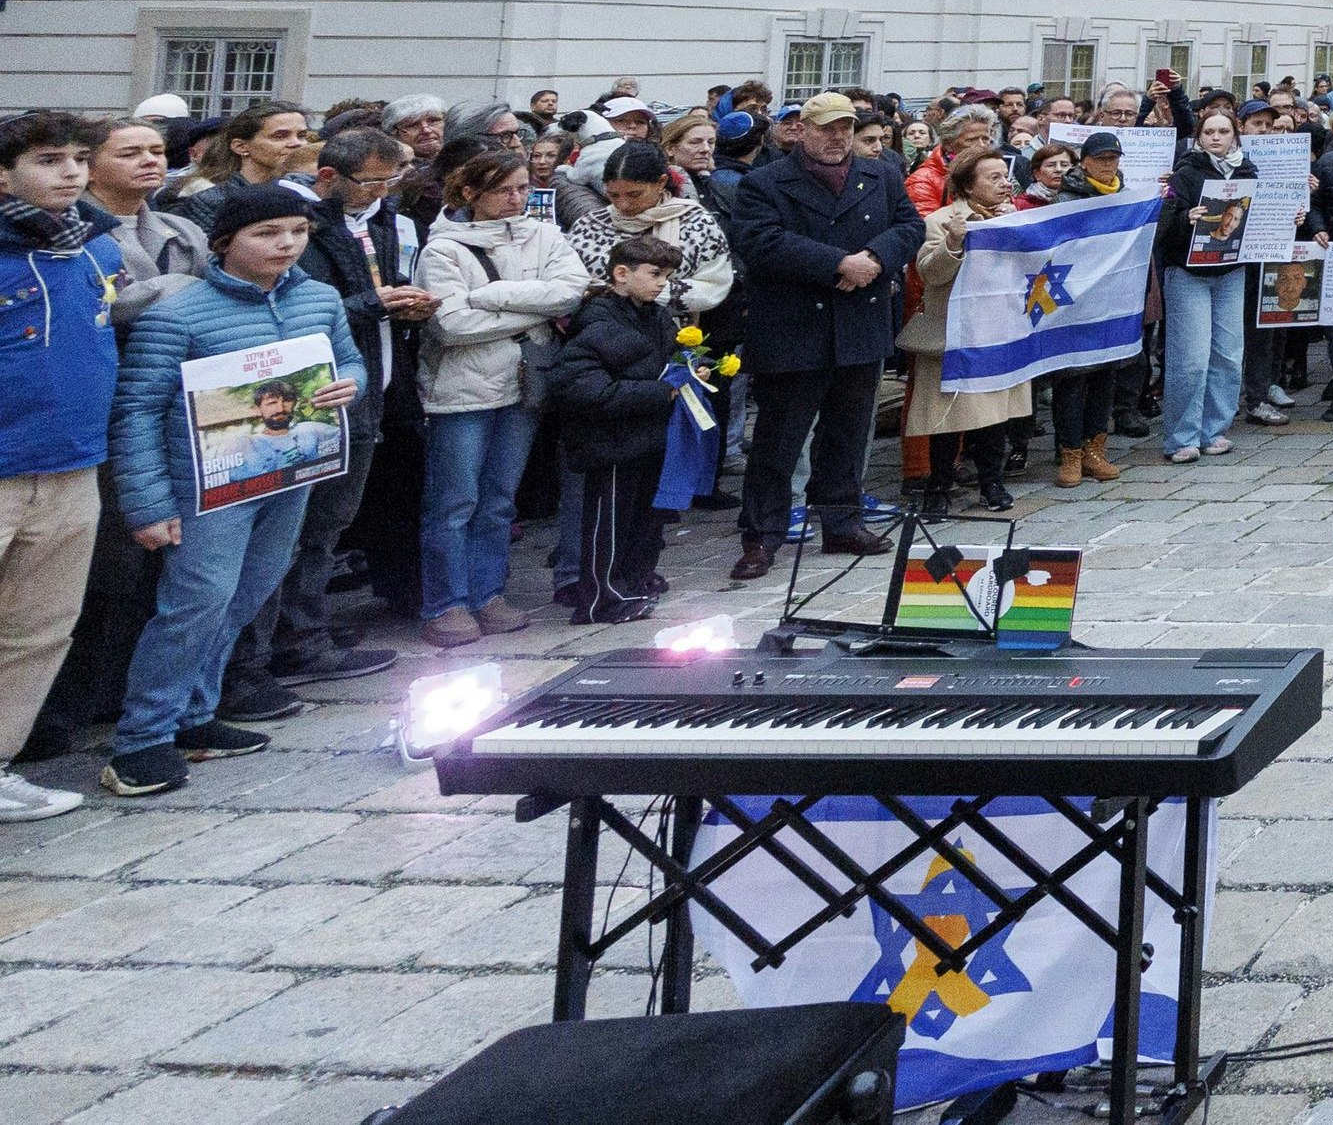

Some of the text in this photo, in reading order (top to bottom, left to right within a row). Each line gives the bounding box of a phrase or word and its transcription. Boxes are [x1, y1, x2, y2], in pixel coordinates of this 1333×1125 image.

[1262, 137, 1285, 145] THEIR
[1287, 136, 1310, 144] VOICE
[1265, 182, 1285, 190] THEIR
[1285, 183, 1306, 191] VOICE
[1244, 243, 1262, 251] YOUR
[202, 452, 244, 475] BRING
[204, 470, 231, 490] HIM
[984, 570, 994, 617] CARDBOARD
